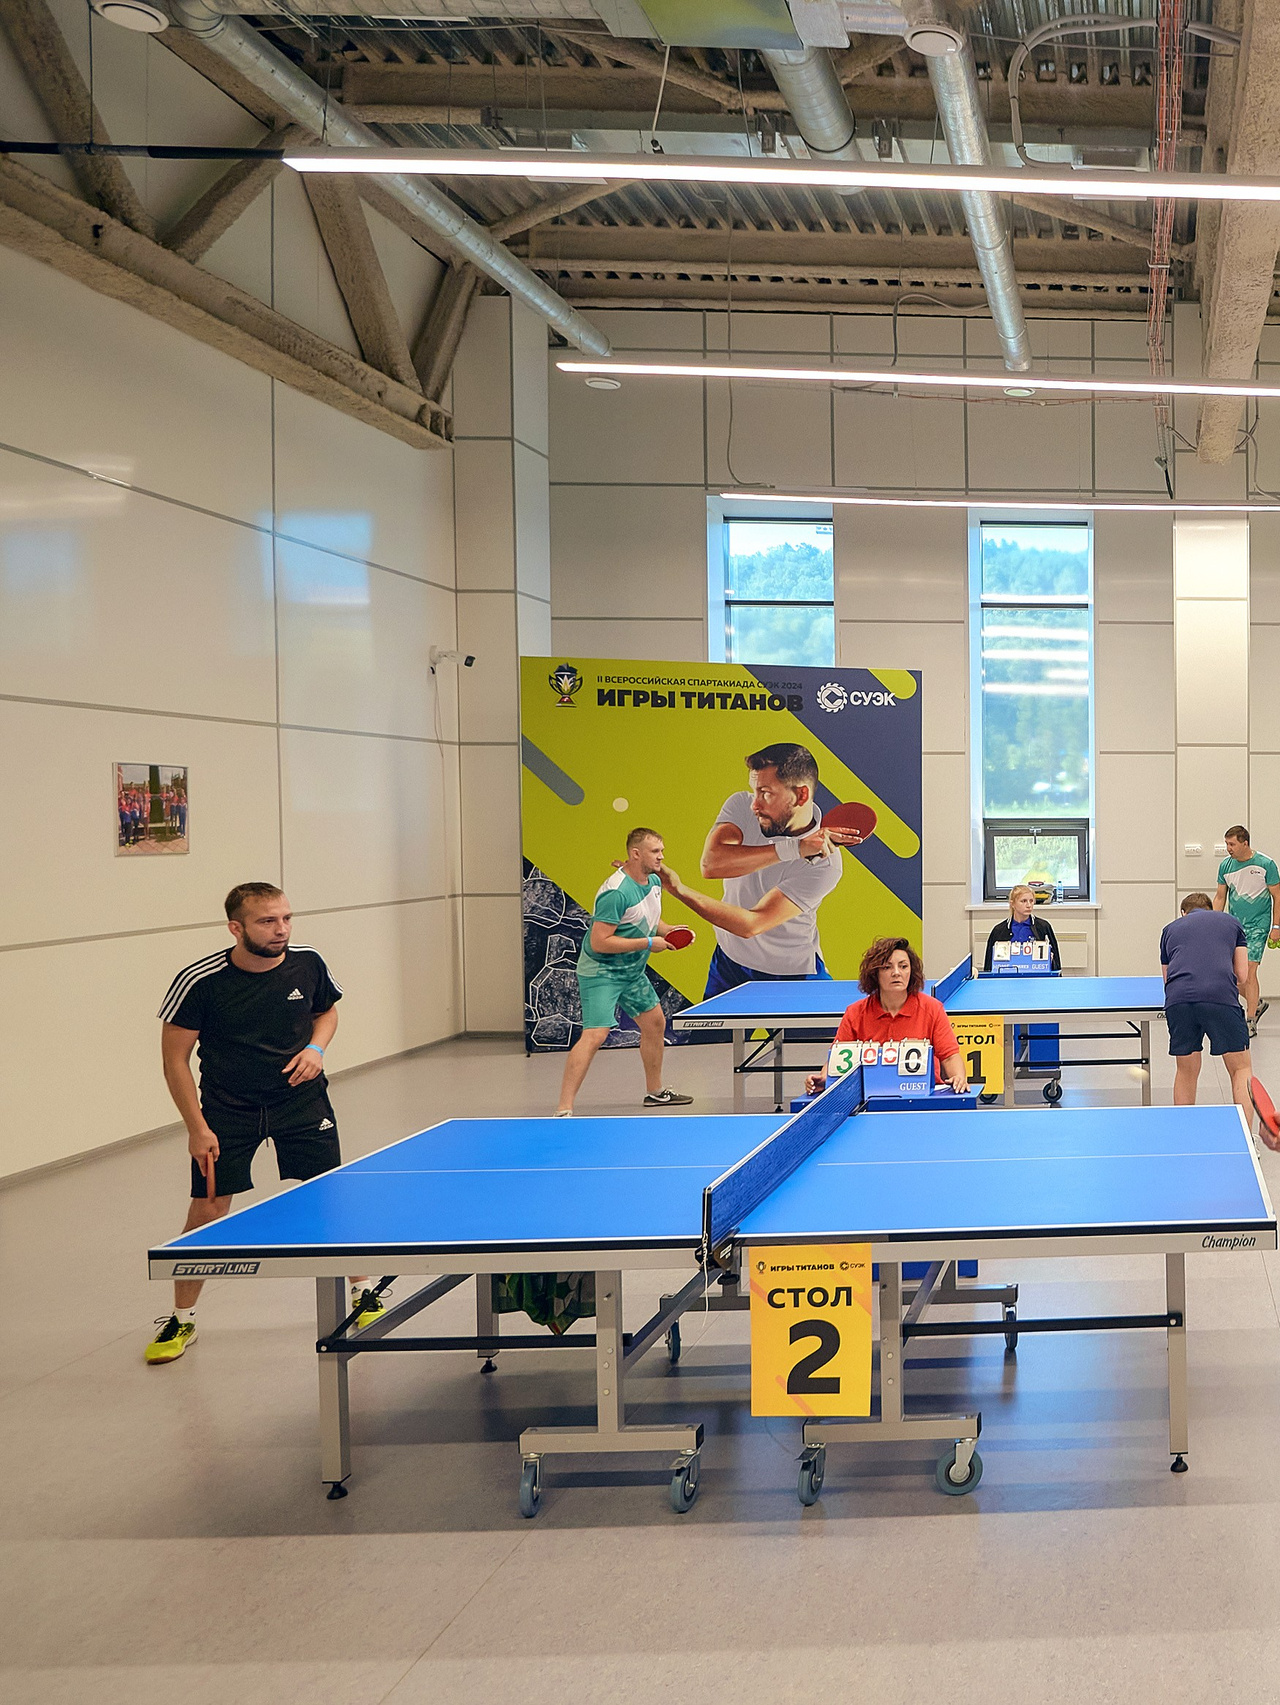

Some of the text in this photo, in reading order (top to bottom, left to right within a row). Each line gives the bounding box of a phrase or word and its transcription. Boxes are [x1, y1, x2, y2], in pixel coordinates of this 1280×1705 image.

[604, 676, 686, 686] ВСЕРОССИЙСКАЯ
[687, 678, 755, 688] СПАРТАКИАДА
[757, 680, 780, 689] СУЭК
[781, 681, 803, 689] 2024
[597, 689, 803, 712] ИГРЫ ТИТАНОВ
[850, 691, 896, 706] СУЭК
[1037, 945, 1044, 959] 1
[956, 1034, 995, 1045] СТОЛ
[836, 1048, 853, 1074] 3
[905, 1048, 922, 1073] 0
[966, 1050, 986, 1084] 1
[899, 1082, 928, 1091] GUEST
[1202, 1234, 1257, 1250] Champion
[175, 1263, 256, 1274] START LINE
[795, 1263, 835, 1271] ТИТАНОВ
[767, 1286, 853, 1309] СТОЛ
[787, 1319, 841, 1394] 2
